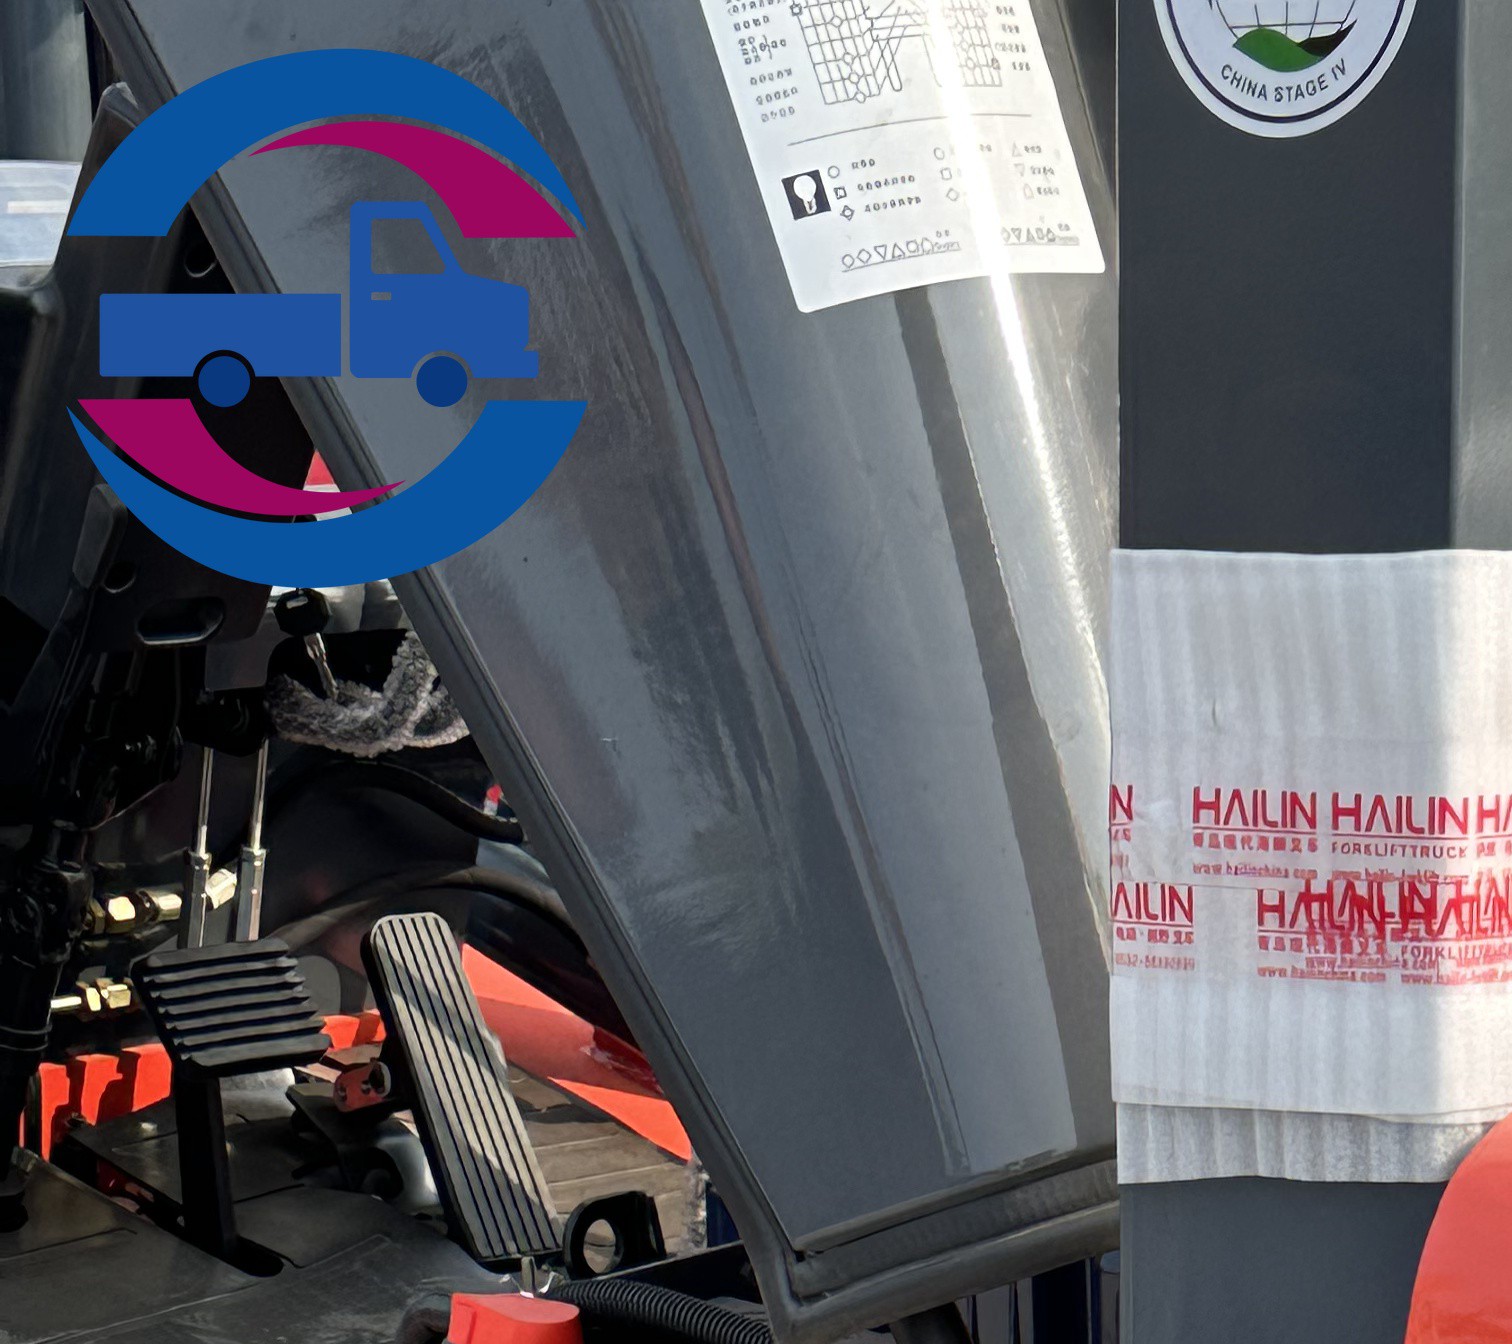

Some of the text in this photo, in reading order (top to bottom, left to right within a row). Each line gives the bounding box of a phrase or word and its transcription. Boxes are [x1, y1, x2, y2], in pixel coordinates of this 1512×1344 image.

[1221, 57, 1347, 102] CHINA STAGE IV
[1192, 785, 1317, 830] HAILIN
[1331, 792, 1470, 836] HAILIN
[1112, 881, 1194, 925] AILIN
